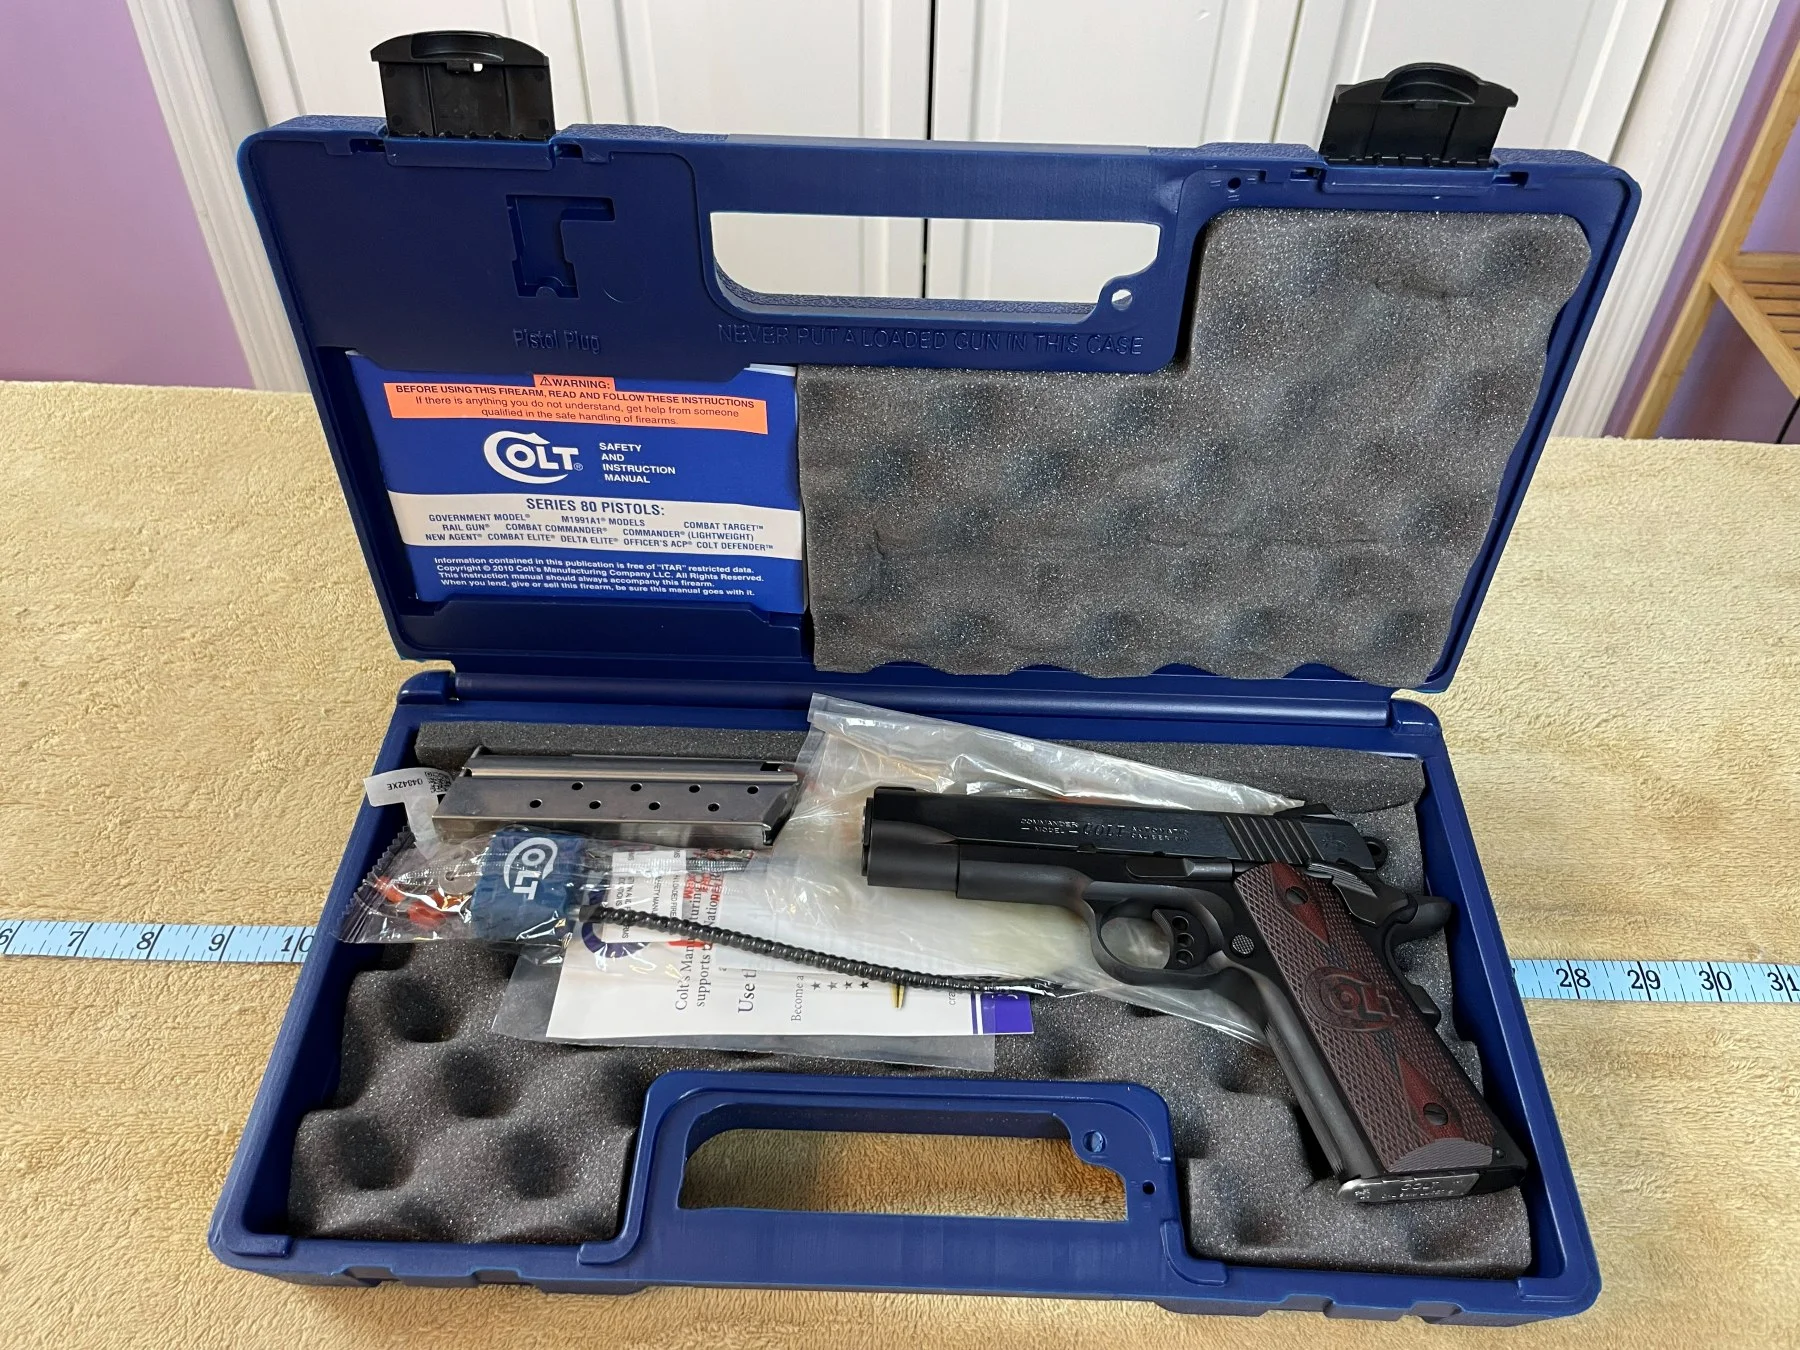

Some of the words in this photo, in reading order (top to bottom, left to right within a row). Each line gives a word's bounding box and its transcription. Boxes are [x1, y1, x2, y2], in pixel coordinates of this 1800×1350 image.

[512, 328, 558, 350] Pistol
[564, 330, 601, 355] Plug
[717, 323, 789, 345] NEVER
[797, 327, 839, 346] PUT
[843, 328, 858, 346] A
[862, 328, 946, 350] LOADED
[954, 330, 999, 352] GUN
[1006, 332, 1027, 352] IN
[1033, 333, 1079, 354] THIS
[1086, 334, 1143, 356] CASE
[551, 379, 611, 390] WARNING:
[396, 385, 438, 393] BEFORE
[440, 386, 473, 394] USING
[474, 386, 497, 395] THIS
[499, 387, 547, 398] FIREARM,
[550, 390, 577, 399] READ
[580, 392, 600, 400] AND
[603, 392, 645, 402] FOLLOW
[648, 395, 680, 404] THESE
[682, 396, 755, 409] INSTRUCTIONS
[416, 396, 423, 405] If
[425, 396, 452, 405] there
[454, 397, 463, 405] is
[466, 397, 508, 408] anything
[510, 400, 529, 408] you
[531, 400, 544, 408] do
[547, 400, 563, 409] not
[566, 400, 624, 412] understand,
[626, 405, 643, 415] get
[644, 406, 666, 415] help
[669, 407, 691, 415] from
[694, 408, 740, 418] someone
[482, 408, 523, 418] qualified
[525, 409, 535, 418] in
[537, 410, 553, 419] the
[556, 410, 576, 419] safe
[580, 413, 621, 424] handling
[624, 414, 633, 423] of
[636, 414, 679, 425] firearms.
[599, 442, 642, 453] SAFETY
[601, 454, 625, 462] AND
[603, 464, 676, 475] INSTRUCTION
[604, 474, 651, 484] MANUAL
[526, 498, 577, 512] SERIES
[581, 501, 598, 513] 80
[602, 502, 665, 516] PISTOLS:
[429, 514, 492, 522] GOVERNMENT
[608, 518, 646, 527] MODELS
[684, 522, 720, 530] COMBAT
[442, 524, 464, 532] RAIL
[506, 524, 542, 532] COMBAT
[688, 531, 754, 542] (LIGHTWEIGHT)
[488, 534, 524, 542] COMBAT
[560, 535, 589, 544] DELTA
[624, 538, 669, 548] OFFICER'S
[696, 542, 719, 550] COLT
[437, 565, 482, 573] Copyright
[544, 567, 607, 577] Manufacturing
[610, 570, 651, 579] Company
[653, 571, 674, 579] LLC.
[690, 573, 719, 581] Rights
[721, 574, 764, 582] Reserved.
[546, 558, 563, 566] this
[566, 560, 615, 569] publication
[627, 562, 645, 570] free
[688, 565, 731, 573] restricted
[733, 566, 754, 574] data.
[546, 574, 577, 582] should
[703, 588, 724, 596] goes
[1020, 818, 1079, 828] COMMANDER
[1083, 822, 1126, 837] COLT
[504, 837, 558, 900] COLT
[0, 928, 13, 946] 6
[67, 931, 84, 949] 7
[136, 932, 155, 950] 8
[208, 934, 226, 952] 9
[281, 935, 316, 953] 10
[696, 955, 712, 1007] supports
[1556, 968, 1591, 988] 28
[1627, 970, 1662, 990] 29
[1698, 971, 1733, 991] 30
[1767, 972, 1800, 992] 31
[674, 974, 691, 1011] Colt's
[738, 984, 755, 1013] Use
[1304, 966, 1400, 1031] COLT
[790, 982, 804, 1022] Become
